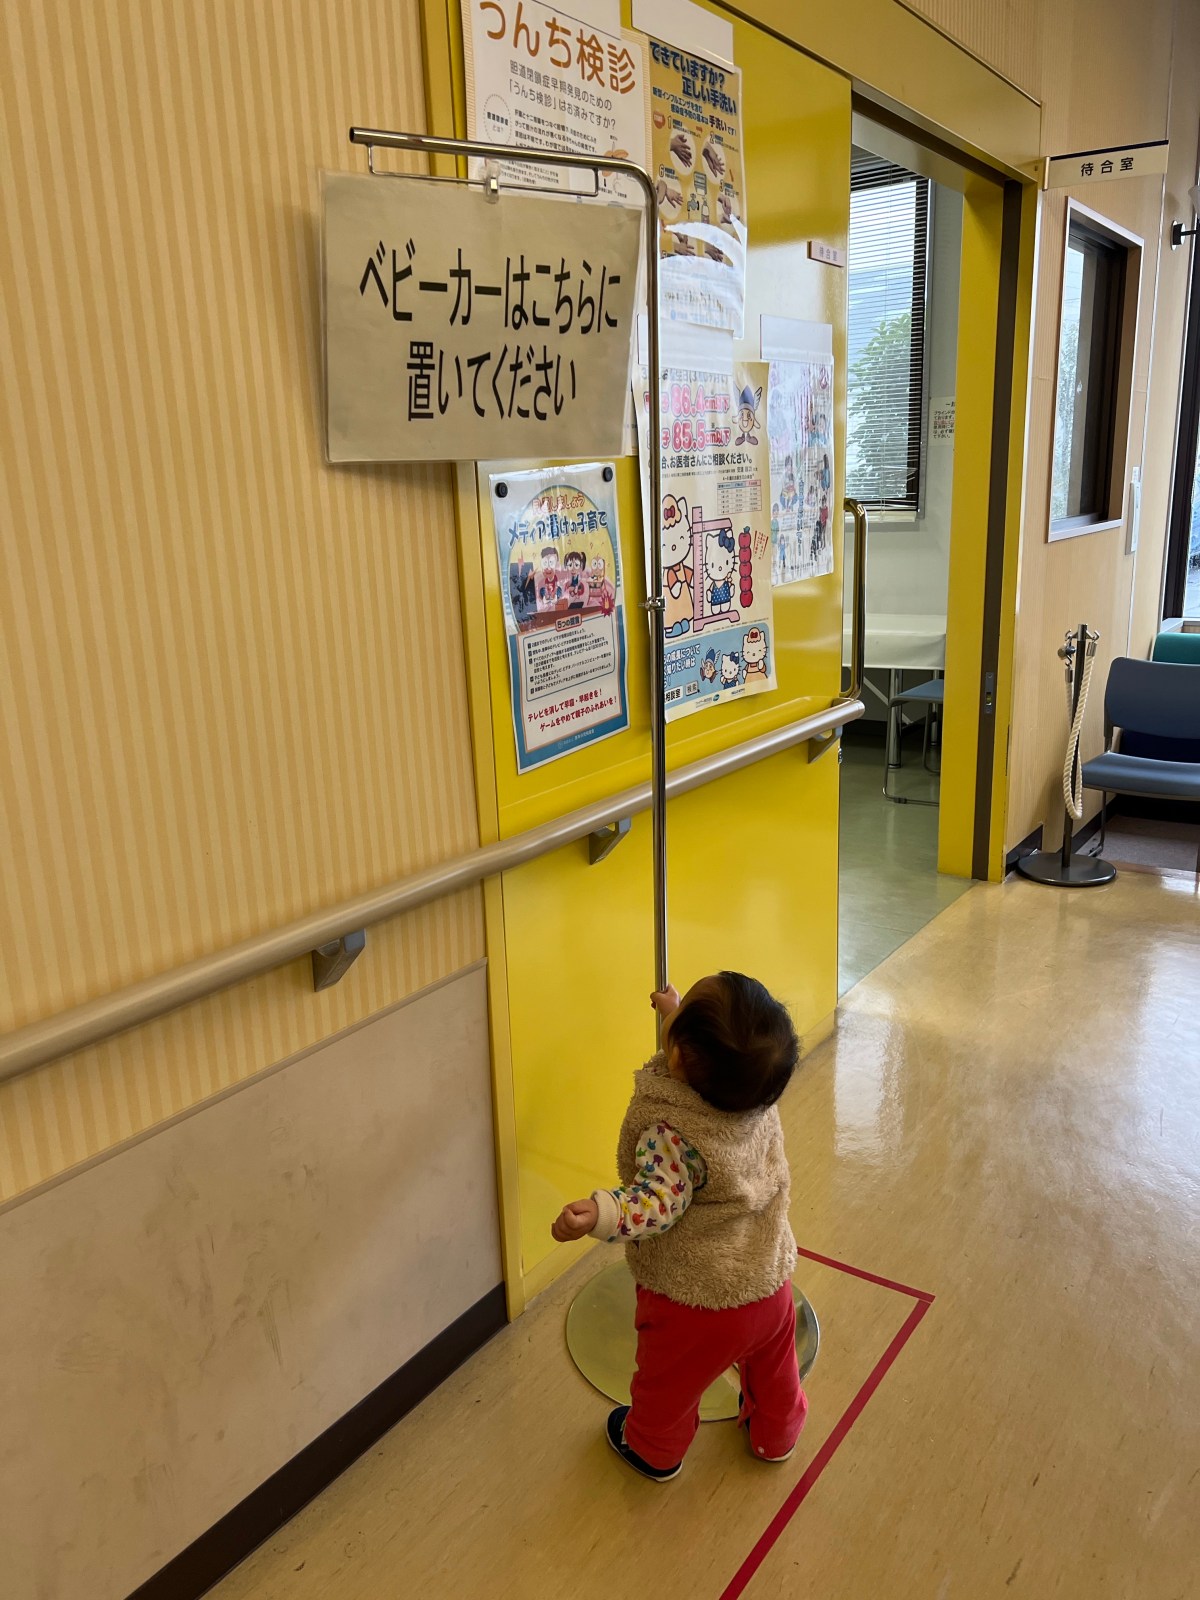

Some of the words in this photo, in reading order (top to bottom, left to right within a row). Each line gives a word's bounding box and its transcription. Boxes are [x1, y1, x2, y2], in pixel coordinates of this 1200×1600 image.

[510, 59, 612, 111] 胆道閉鎖症早期発見のための
[649, 41, 725, 88] できていますか?
[509, 79, 616, 129] 「うんち検診」はお済みですか?
[682, 76, 737, 114] 正しい手洗い
[1081, 157, 1134, 177] 待合室
[359, 238, 621, 334] ベビーカーはこちらに
[406, 341, 577, 422] 置いてください
[508, 510, 608, 546] メディア漬けの子育て
